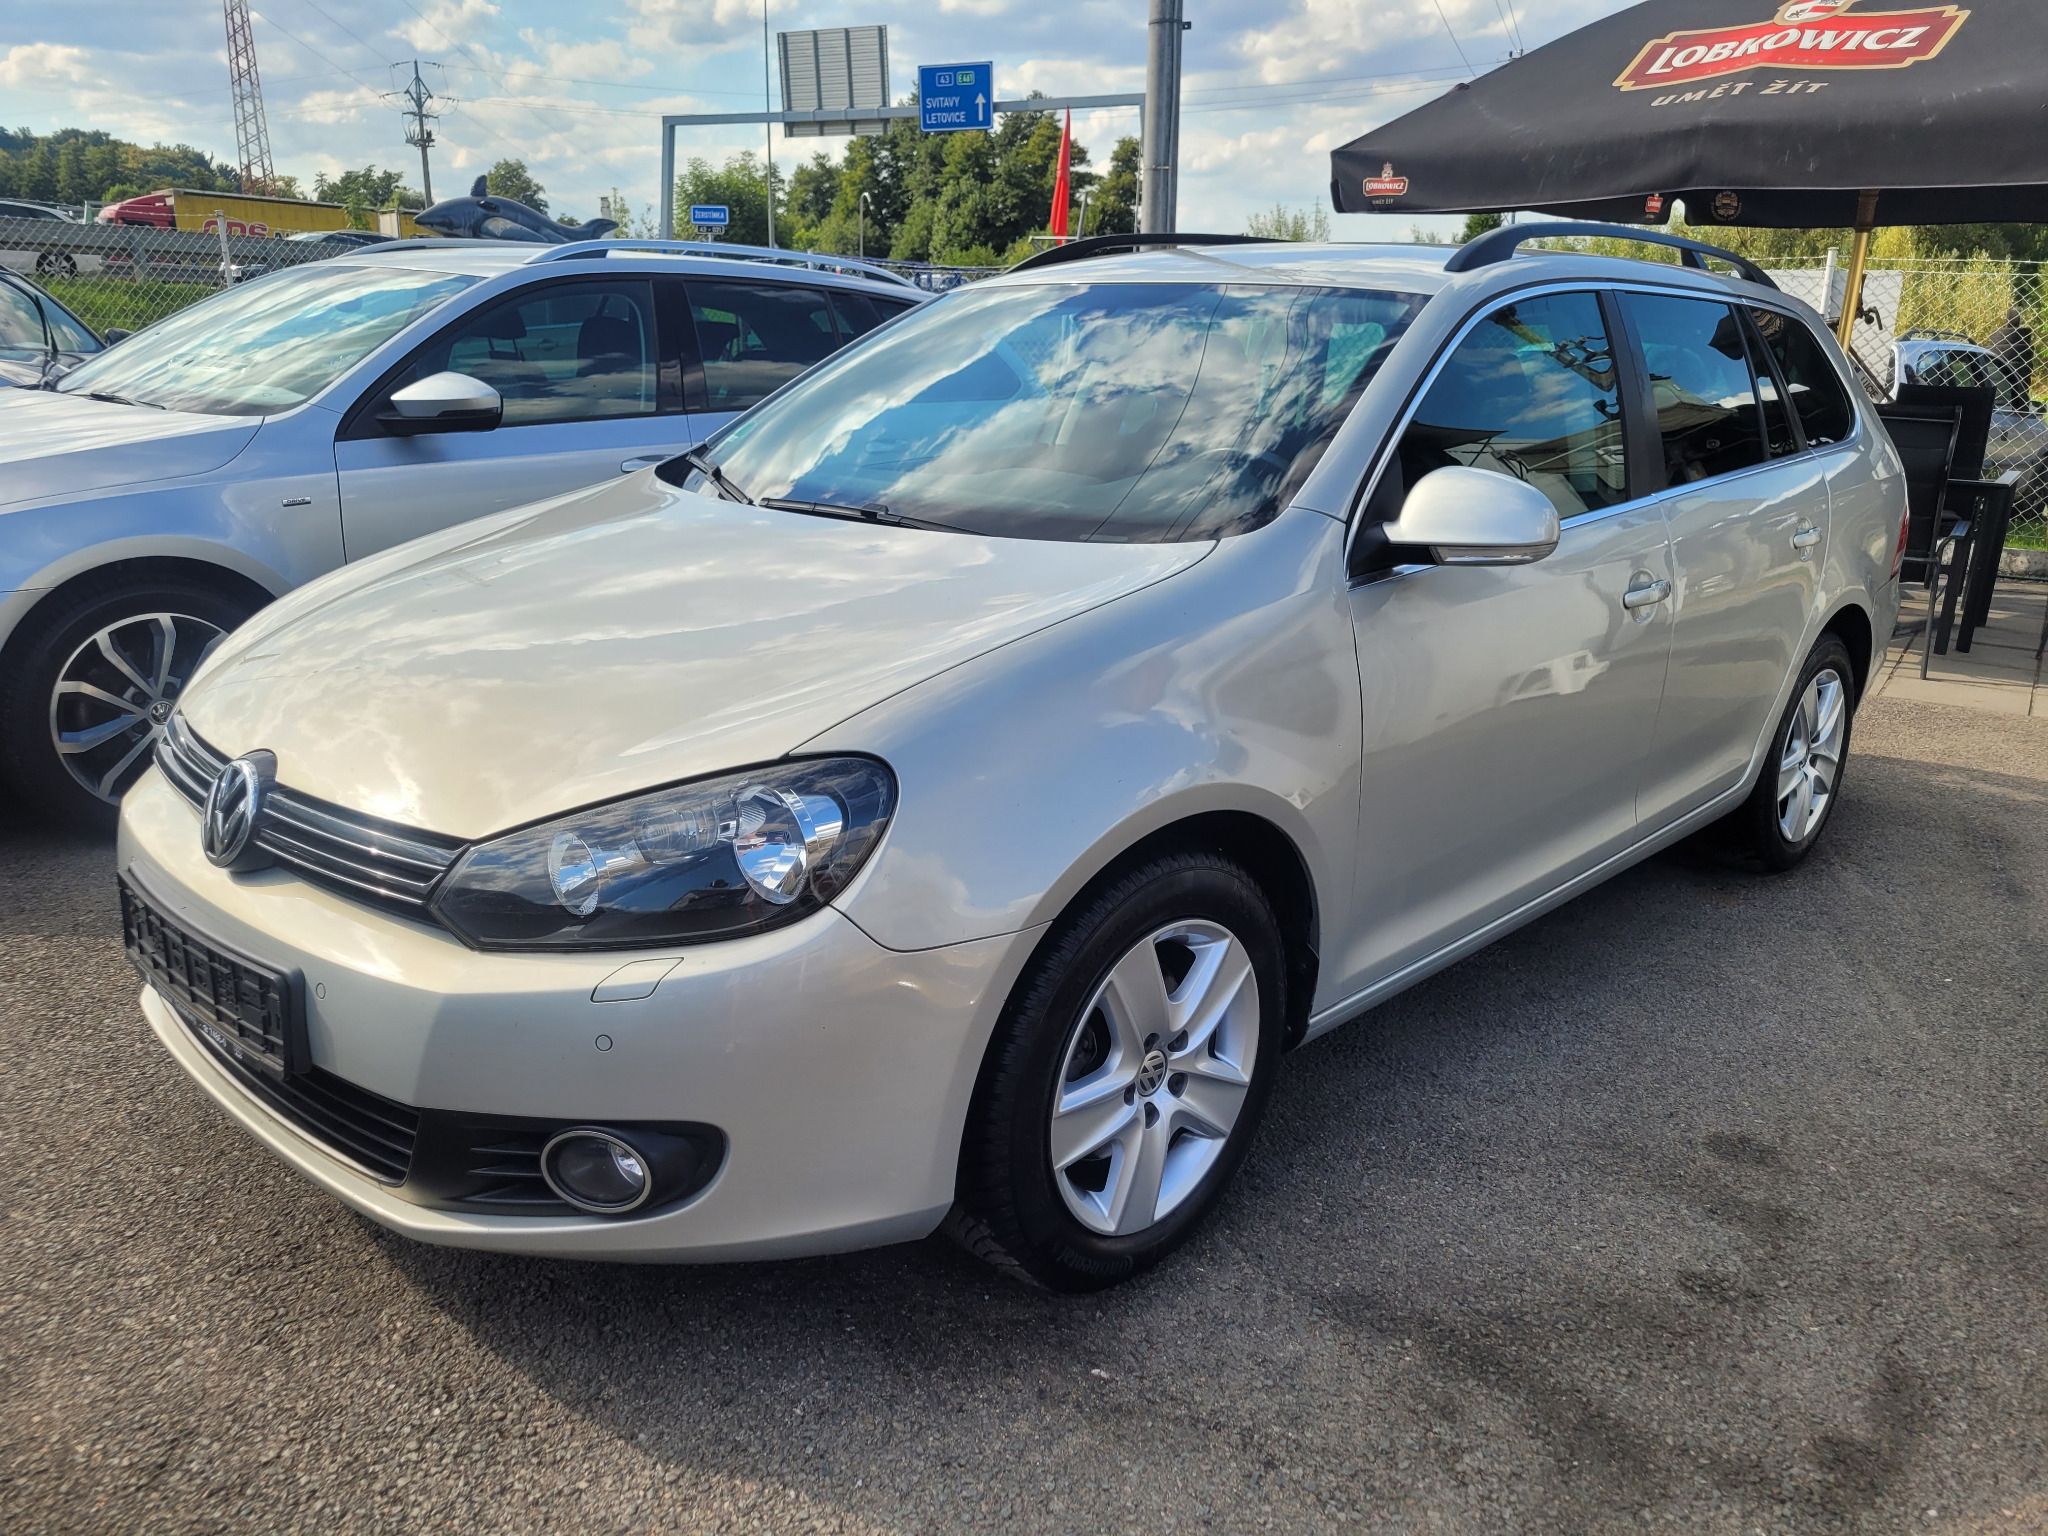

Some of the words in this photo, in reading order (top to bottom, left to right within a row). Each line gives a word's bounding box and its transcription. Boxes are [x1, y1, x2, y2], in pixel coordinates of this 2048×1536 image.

[1645, 26, 1930, 75] LOBKOWICZ
[940, 75, 950, 84] 43
[1650, 82, 1753, 107] UMĚT
[1760, 79, 1830, 96] ŽÍT
[926, 97, 960, 109] SVITAVY
[926, 112, 967, 124] LETOVICE
